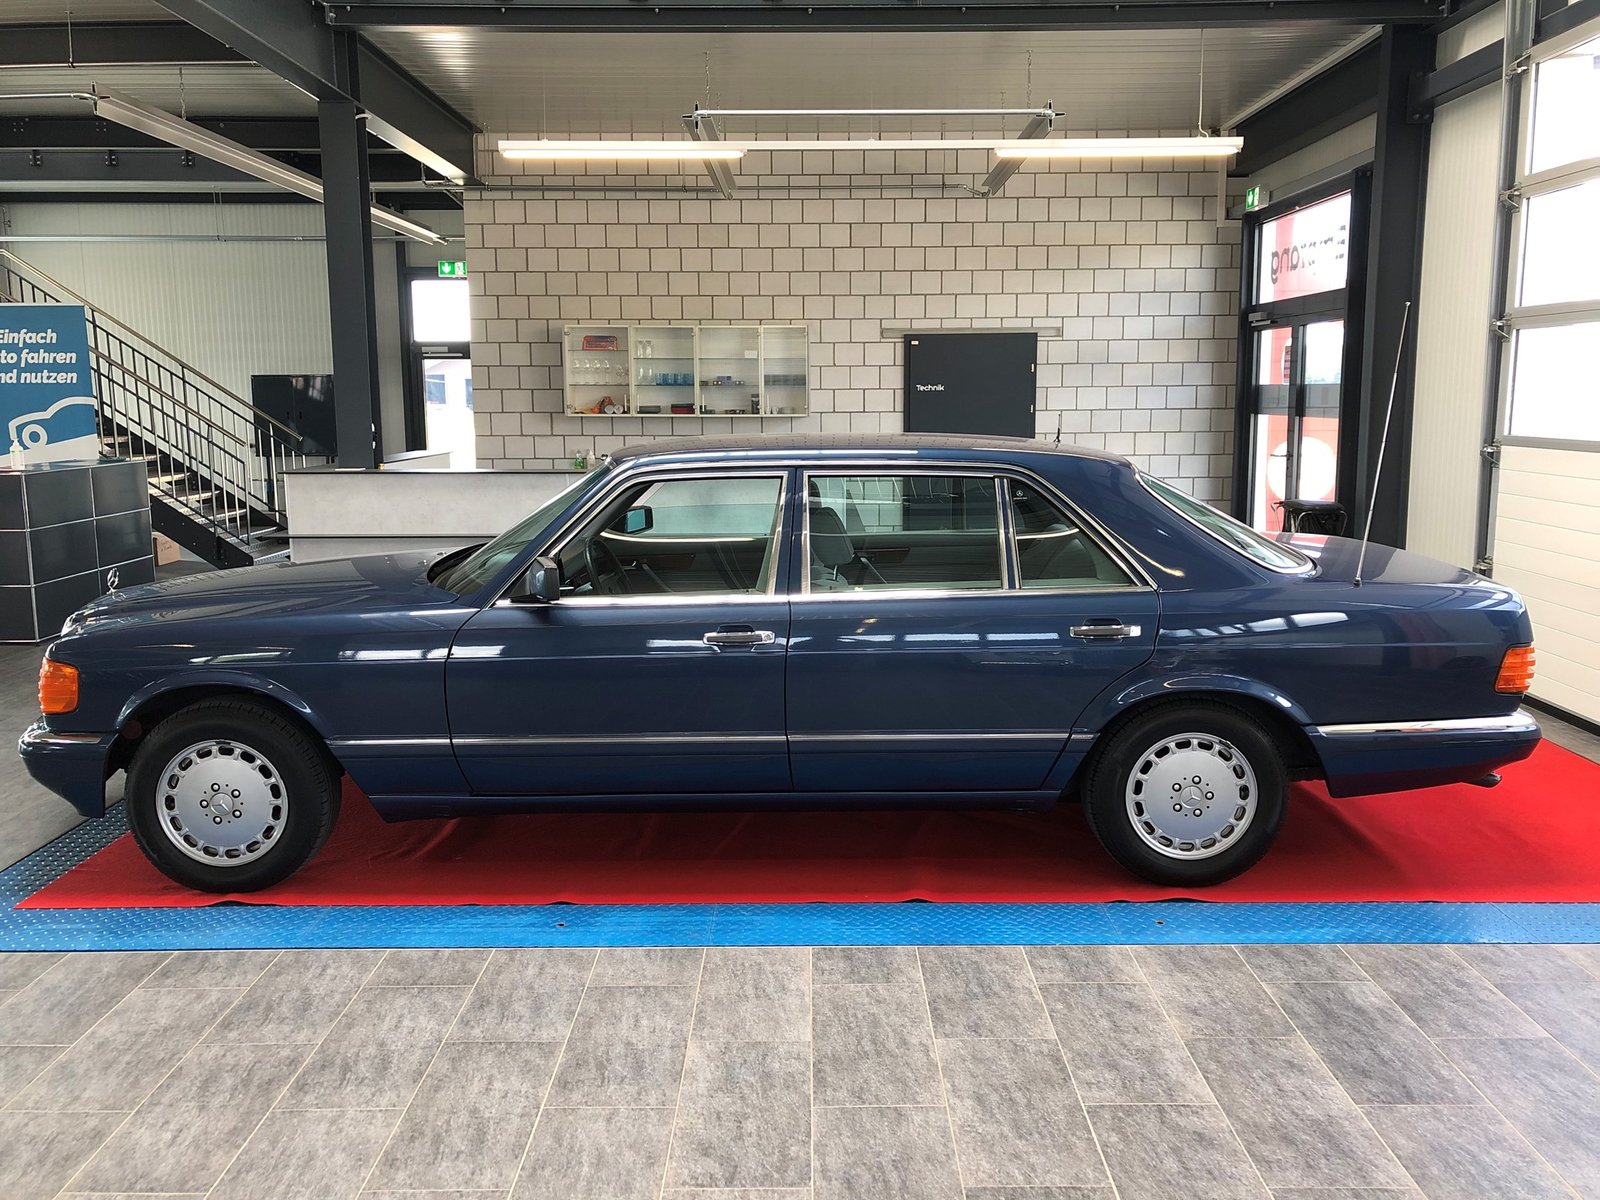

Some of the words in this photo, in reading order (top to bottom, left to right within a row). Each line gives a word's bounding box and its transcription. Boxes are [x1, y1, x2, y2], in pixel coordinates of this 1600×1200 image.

[20, 348, 77, 368] fahren
[20, 369, 78, 384] nutzen
[915, 383, 945, 392] Technik
